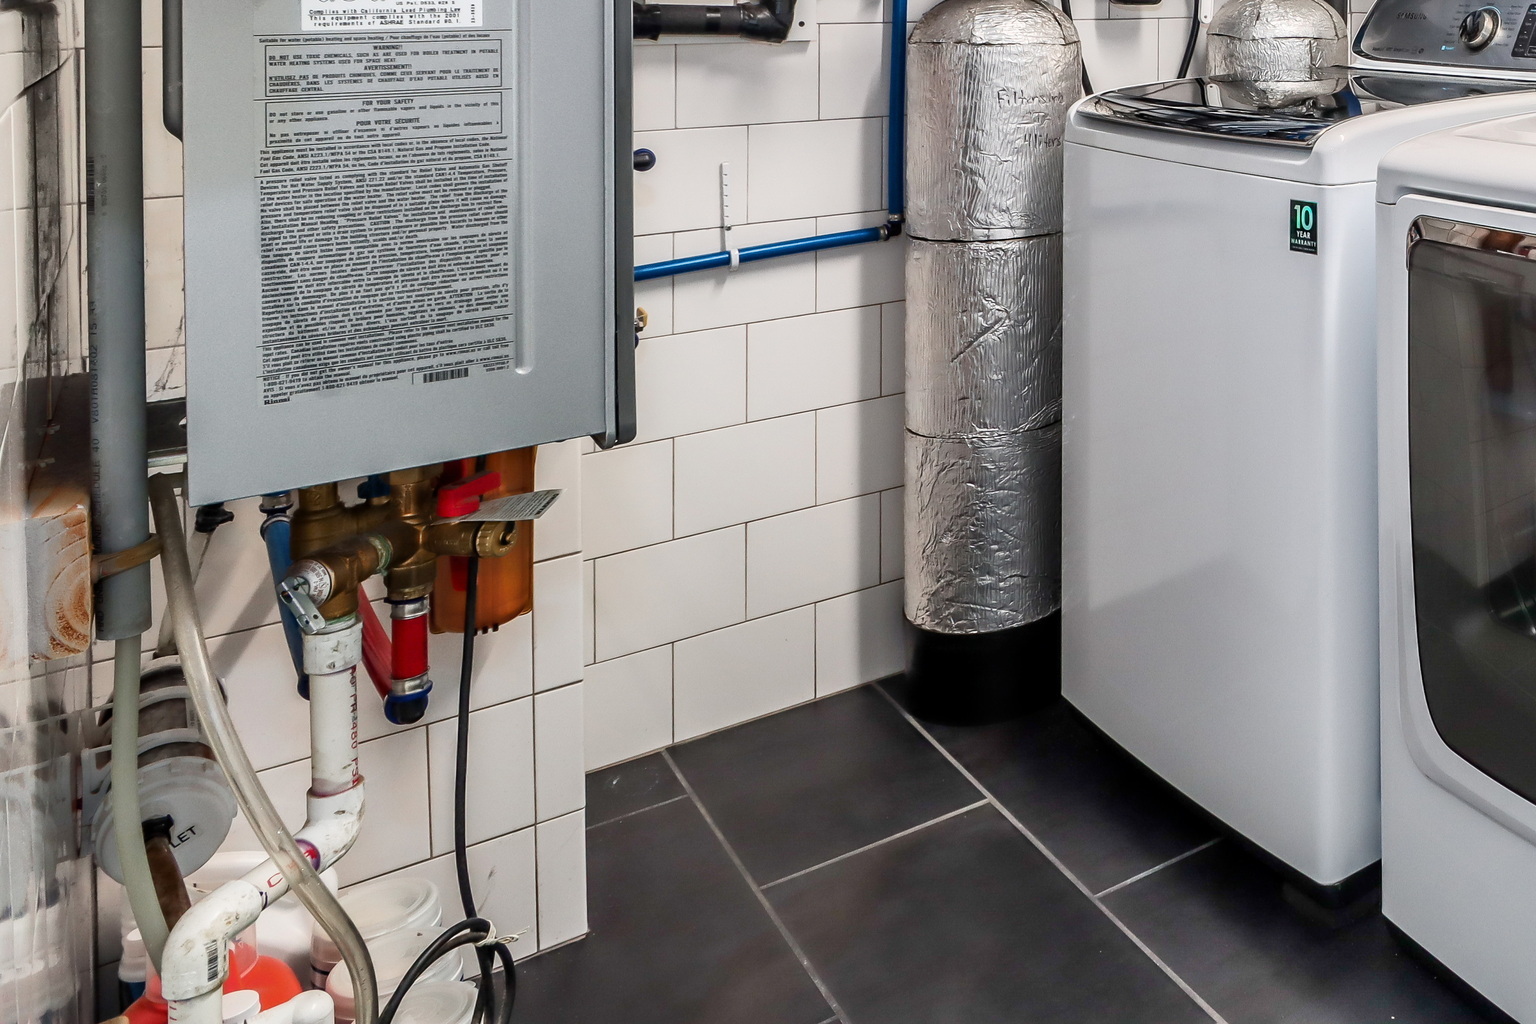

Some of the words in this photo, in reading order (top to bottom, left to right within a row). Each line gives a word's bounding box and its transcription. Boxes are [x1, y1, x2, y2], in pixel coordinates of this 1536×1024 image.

[1294, 204, 1313, 230] 10
[1296, 230, 1310, 239] YEAR
[1291, 238, 1316, 247] WARRANTY
[263, 396, 291, 406] Rinnai
[92, 438, 100, 453] 40
[170, 826, 196, 848] LET
